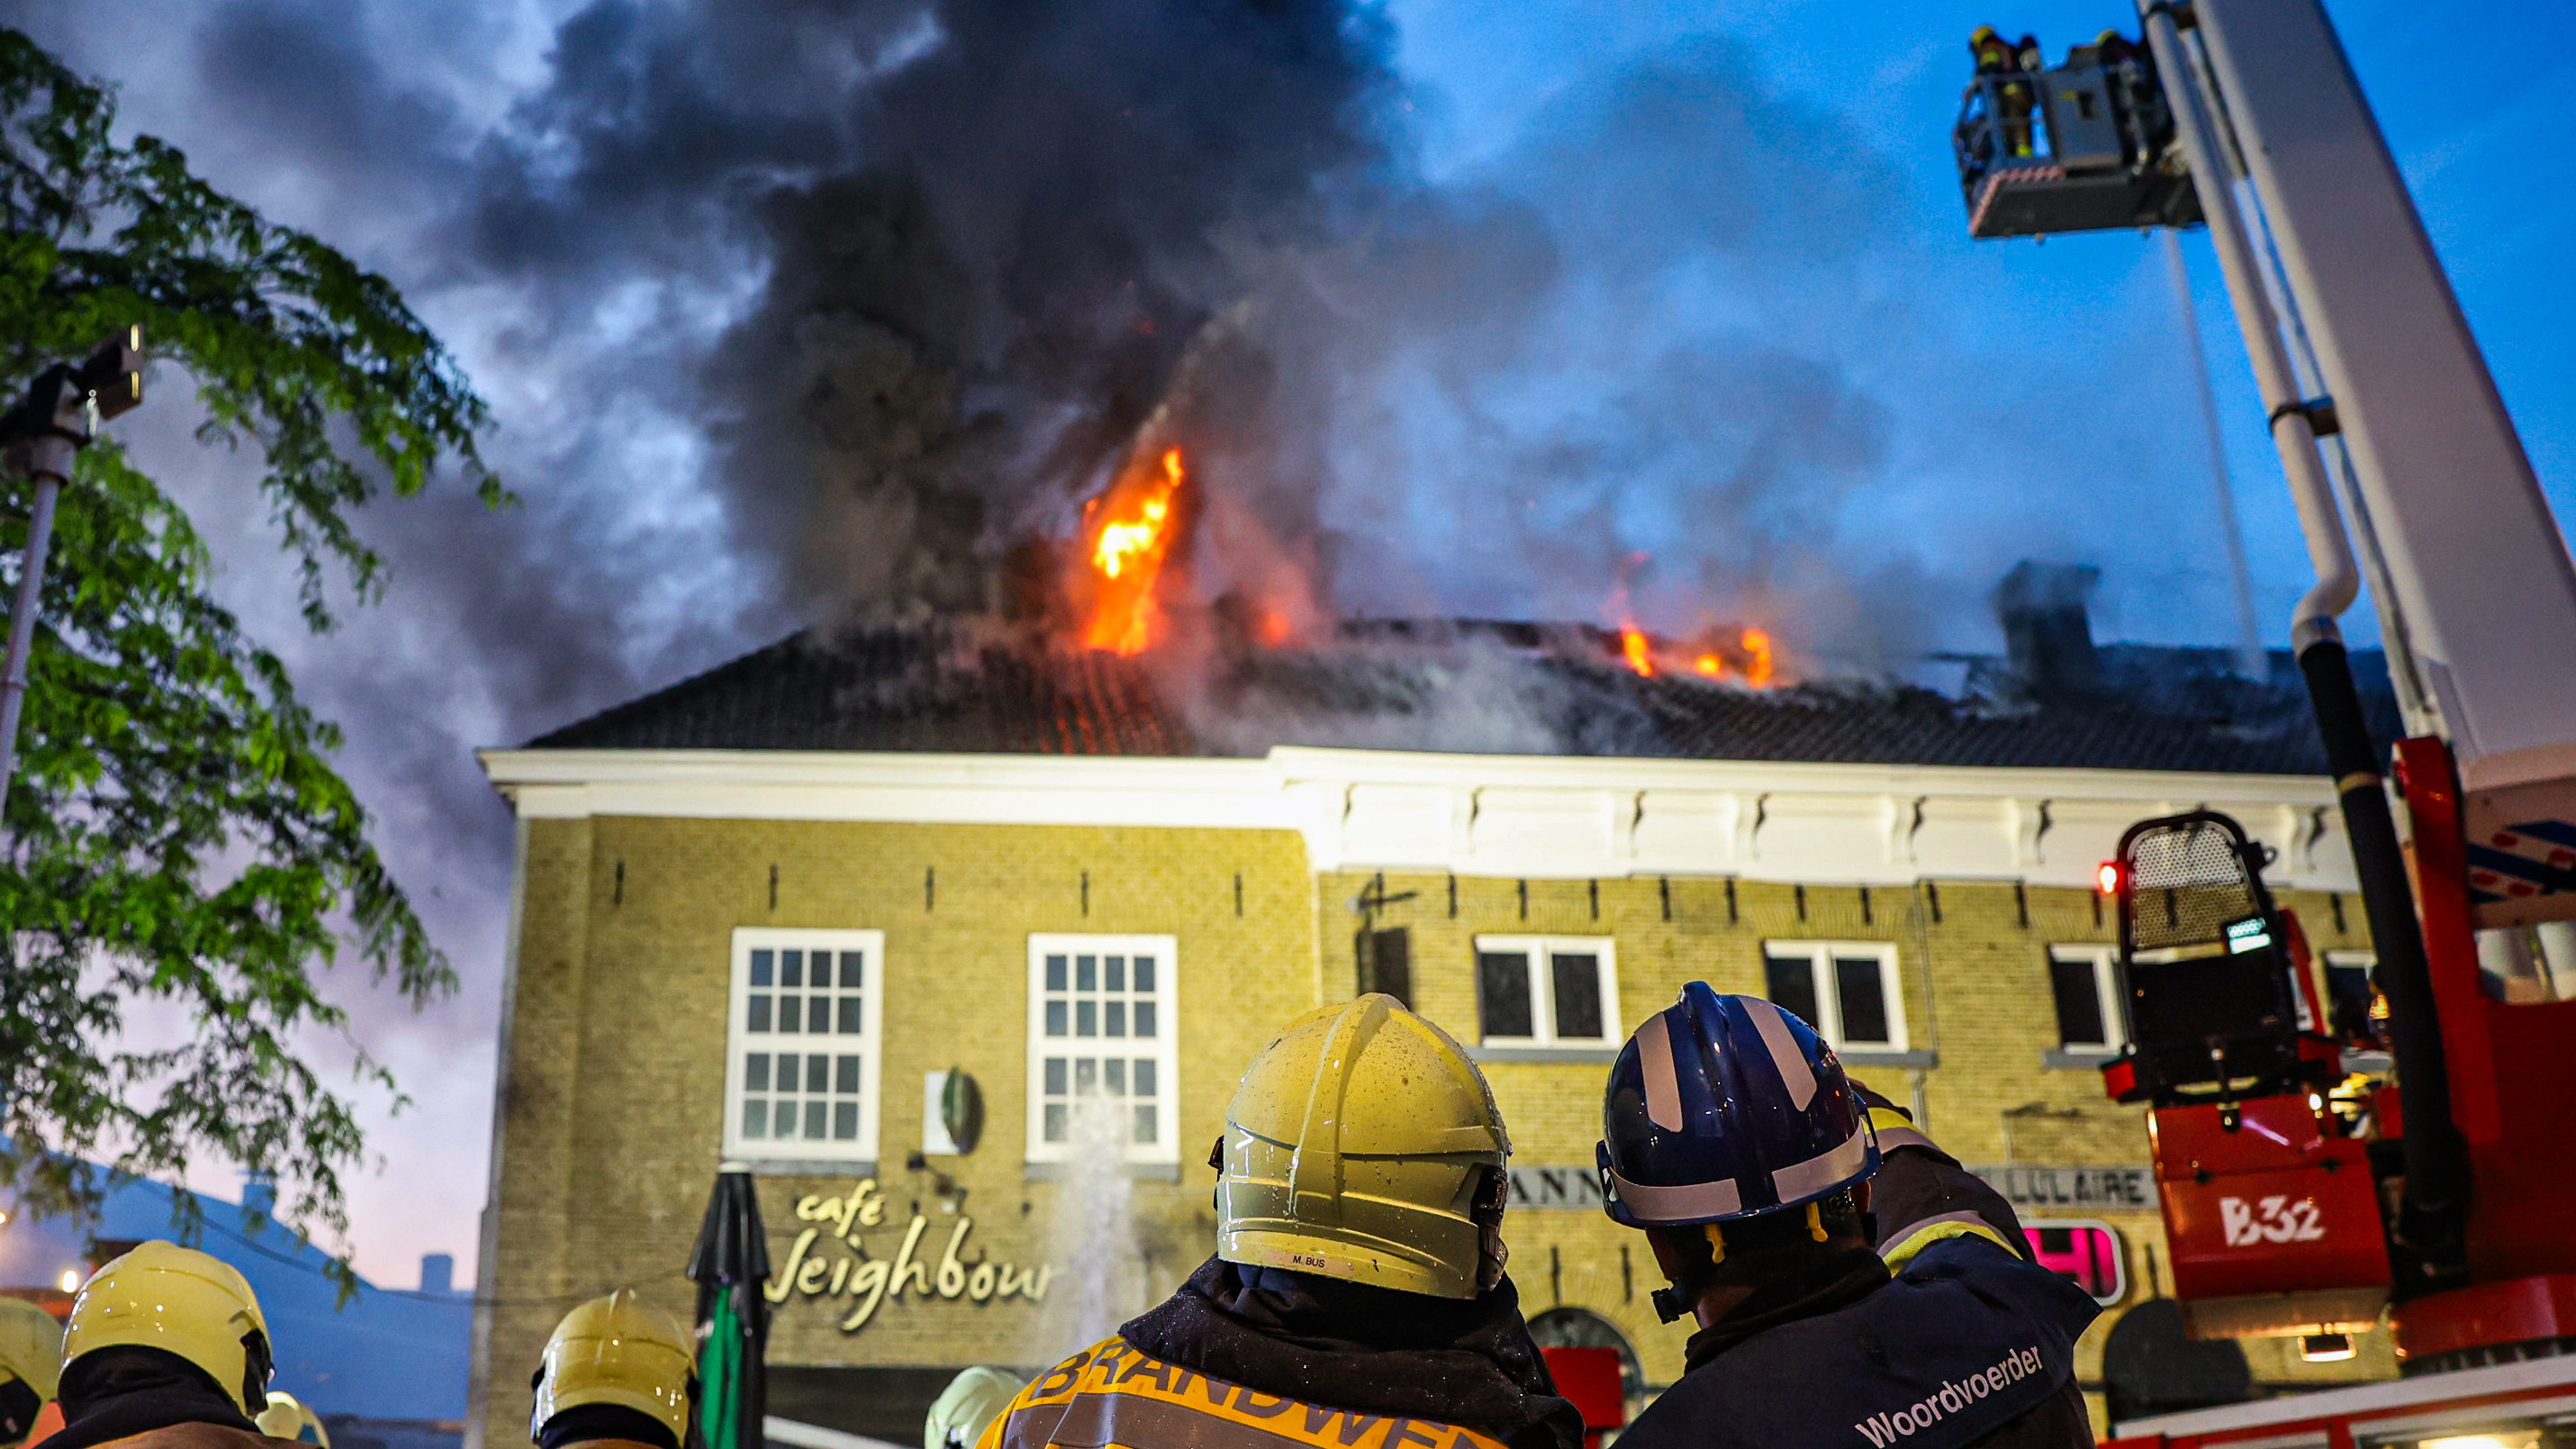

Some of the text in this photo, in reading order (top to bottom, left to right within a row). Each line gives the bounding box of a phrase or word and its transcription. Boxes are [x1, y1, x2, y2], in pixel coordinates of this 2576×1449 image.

[2219, 1194, 2326, 1246] B32
[1292, 1255, 1325, 1268] M. BUS
[1028, 1341, 1479, 1449] BRANDWE
[1855, 1345, 2043, 1449] Woordvoerder
